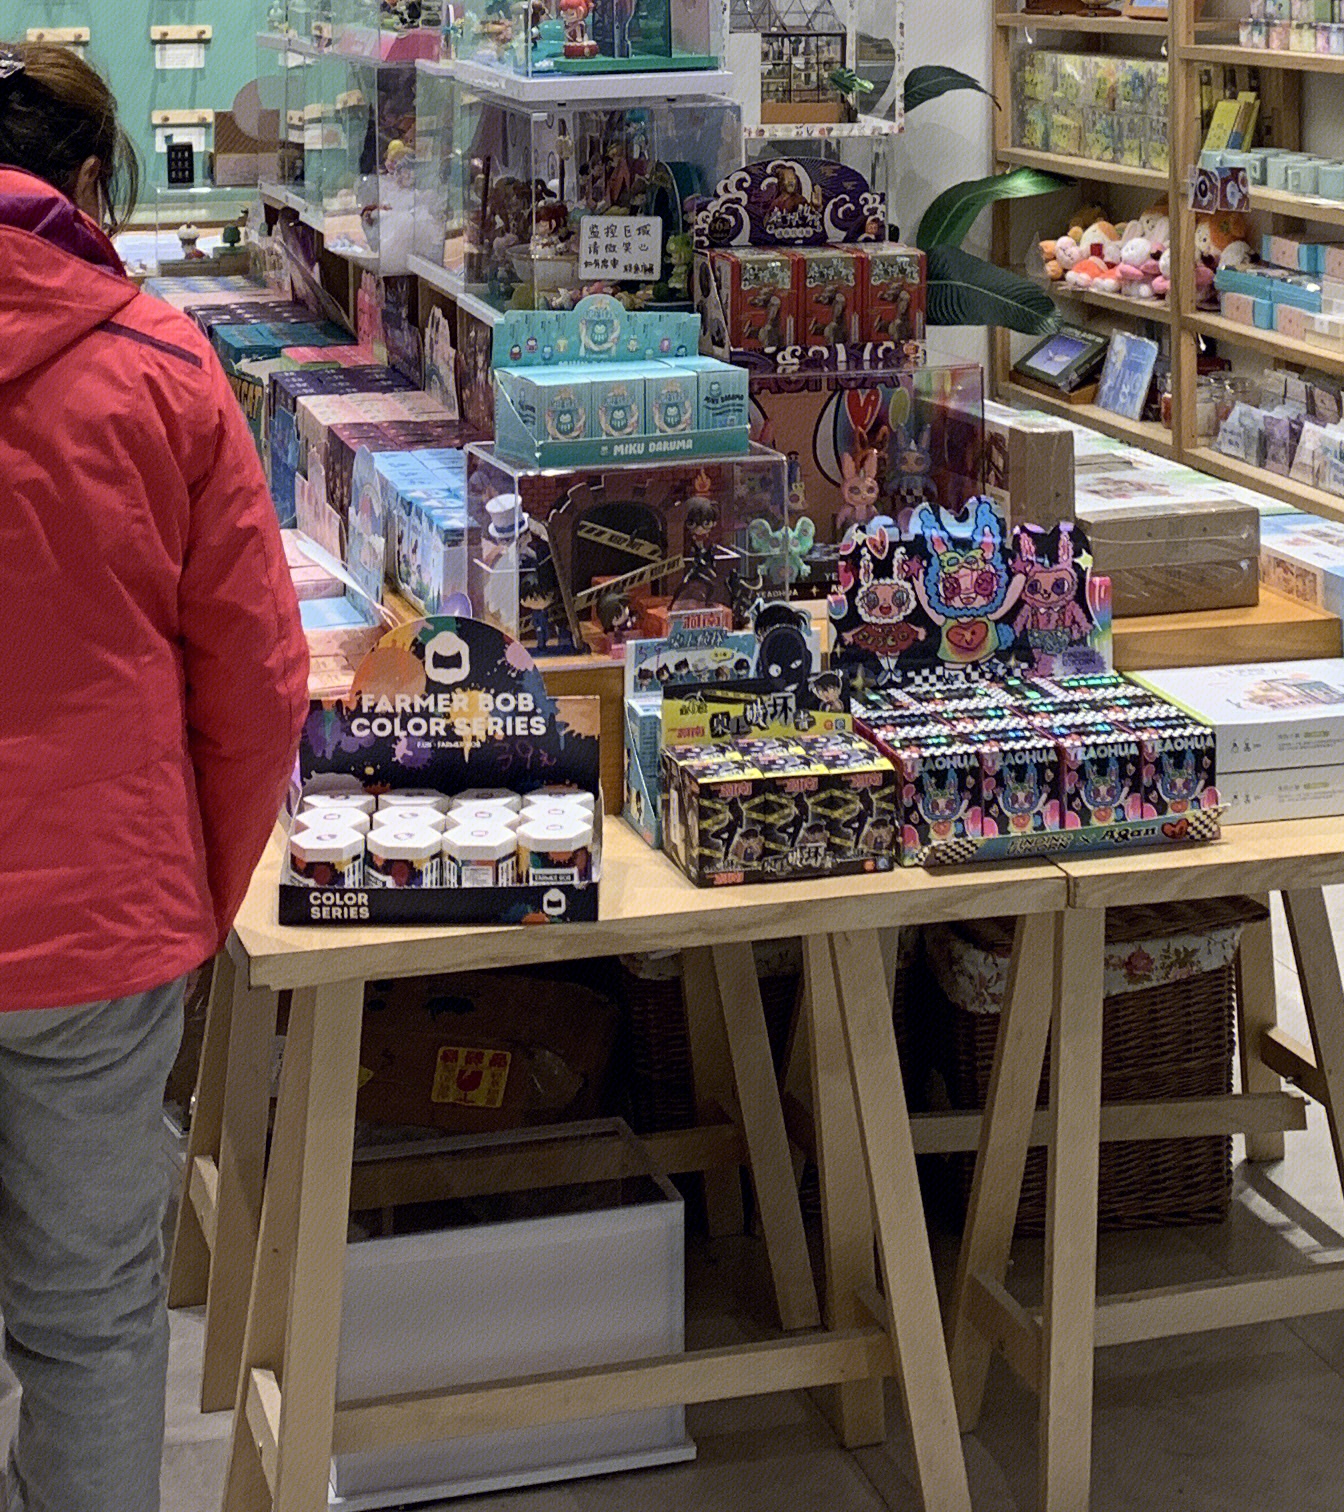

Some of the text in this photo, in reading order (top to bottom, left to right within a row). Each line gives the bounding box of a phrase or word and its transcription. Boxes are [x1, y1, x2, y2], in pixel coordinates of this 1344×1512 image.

[588, 223, 651, 239] 监控区域
[588, 241, 632, 255] 请微笑
[613, 438, 693, 455] MIKU DARUMA
[362, 693, 470, 713] FARMER
[351, 716, 547, 738] COLOR SERIES
[309, 892, 368, 906] COLOR
[310, 906, 369, 920] SERIES
